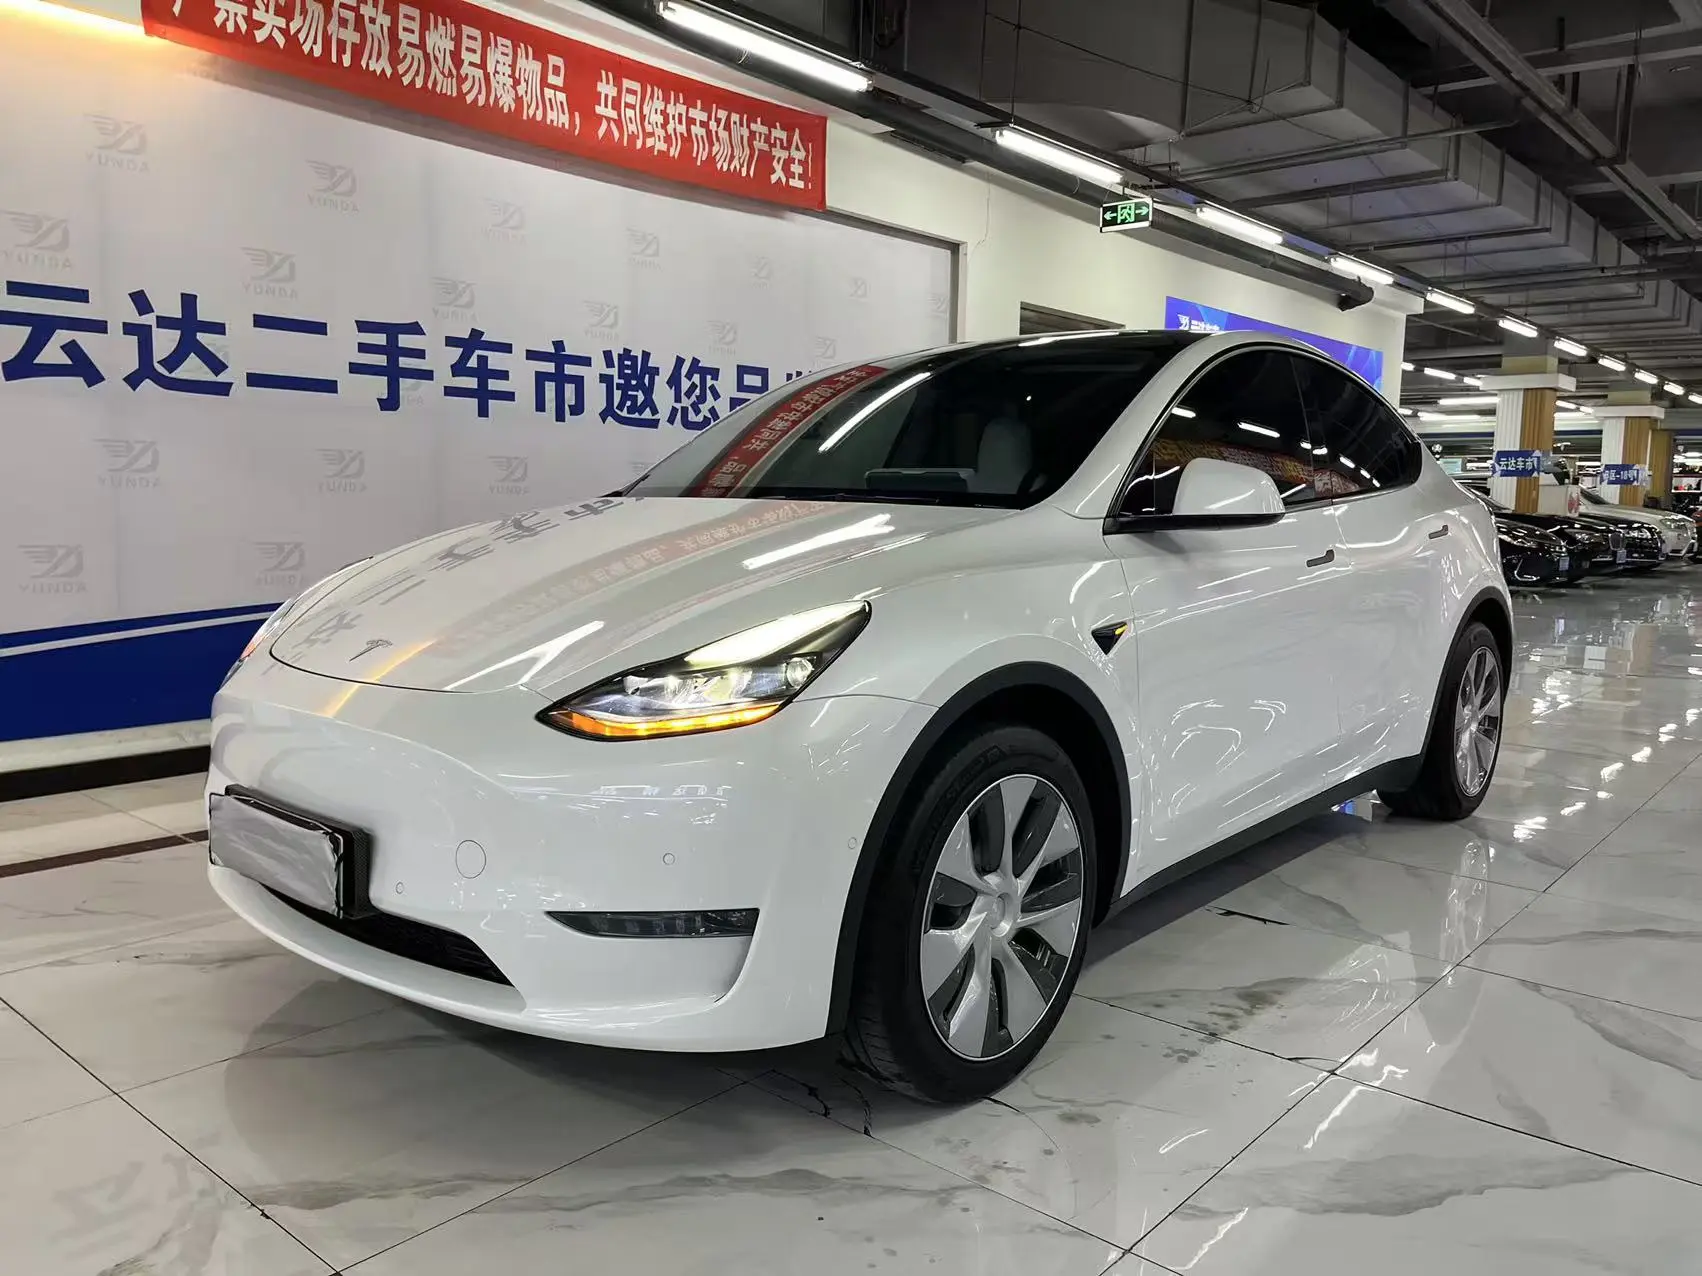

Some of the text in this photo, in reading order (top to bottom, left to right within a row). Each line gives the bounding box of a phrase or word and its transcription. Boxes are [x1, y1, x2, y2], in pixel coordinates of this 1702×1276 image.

[85, 152, 150, 173] YUNDA
[306, 192, 360, 214] YUNDA
[242, 283, 299, 300] YUNDA
[0, 280, 812, 430] 云达二手车市邀您品
[1499, 456, 1534, 470] 云达车市
[97, 476, 161, 489] YUNDA
[316, 480, 367, 494] YUNDA
[488, 484, 530, 495] YUNDA
[18, 583, 88, 595] YUNDA
